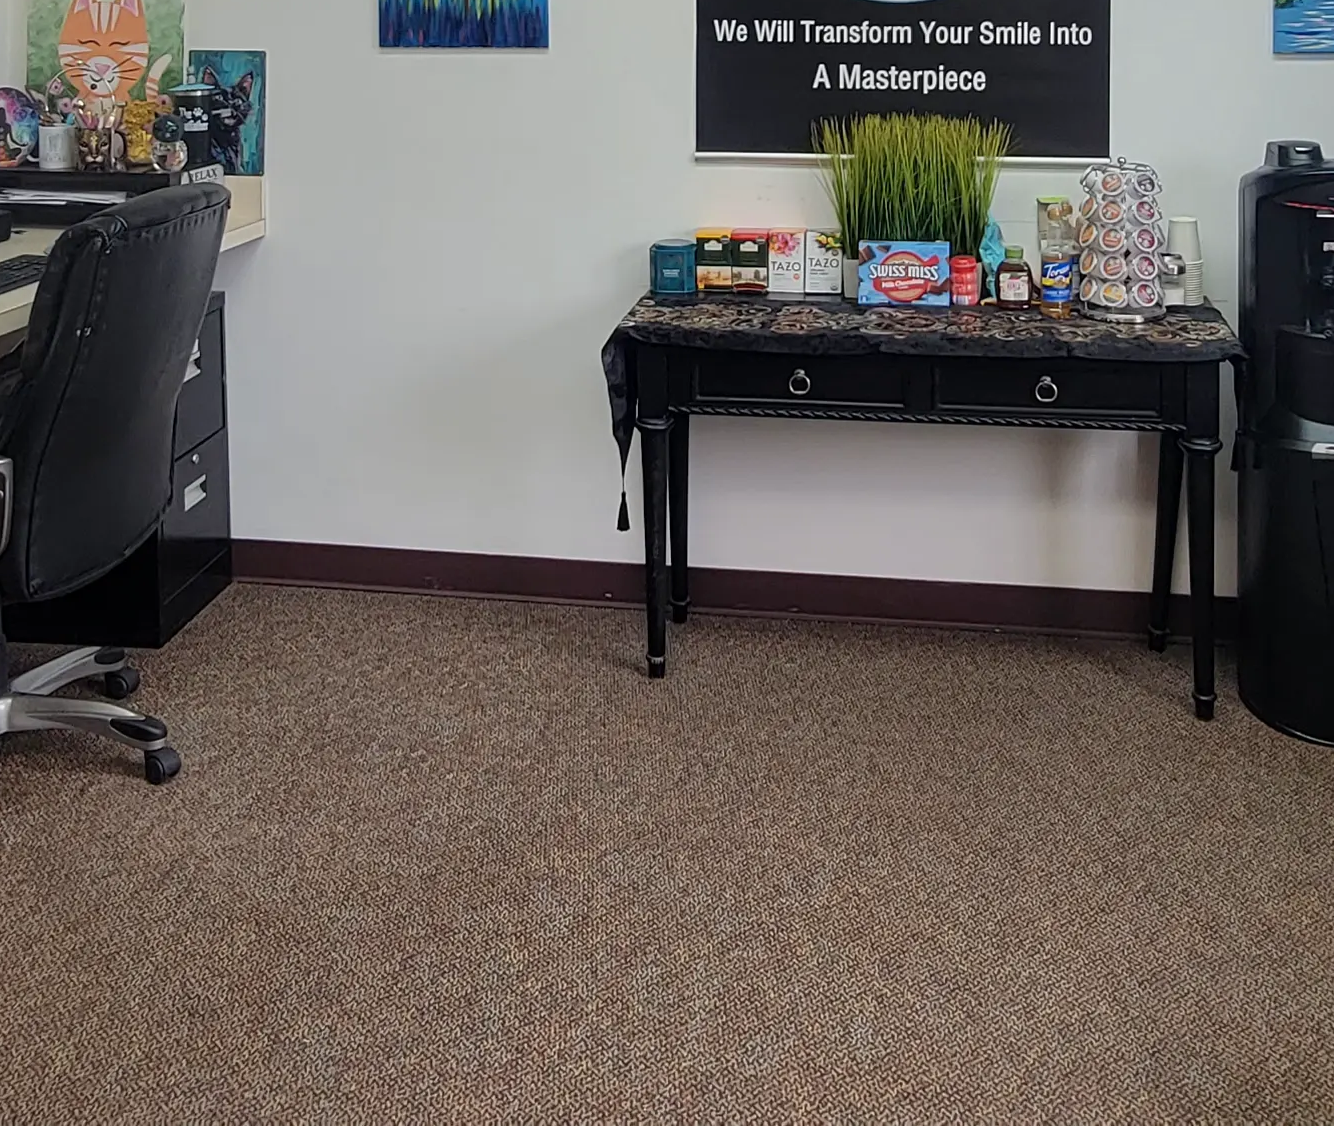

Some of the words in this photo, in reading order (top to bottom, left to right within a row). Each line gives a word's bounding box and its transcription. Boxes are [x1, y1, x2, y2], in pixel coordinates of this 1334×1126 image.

[713, 19, 749, 43] We
[753, 19, 795, 43] Will
[799, 19, 913, 44] Transform
[918, 20, 974, 45] Your
[978, 20, 1042, 46] Smile
[1049, 21, 1093, 46] Into
[811, 63, 832, 90] A
[838, 63, 987, 95] Masterpiece
[770, 260, 802, 272] TAZO
[808, 257, 840, 268] TAZO
[868, 263, 906, 279] SWISS
